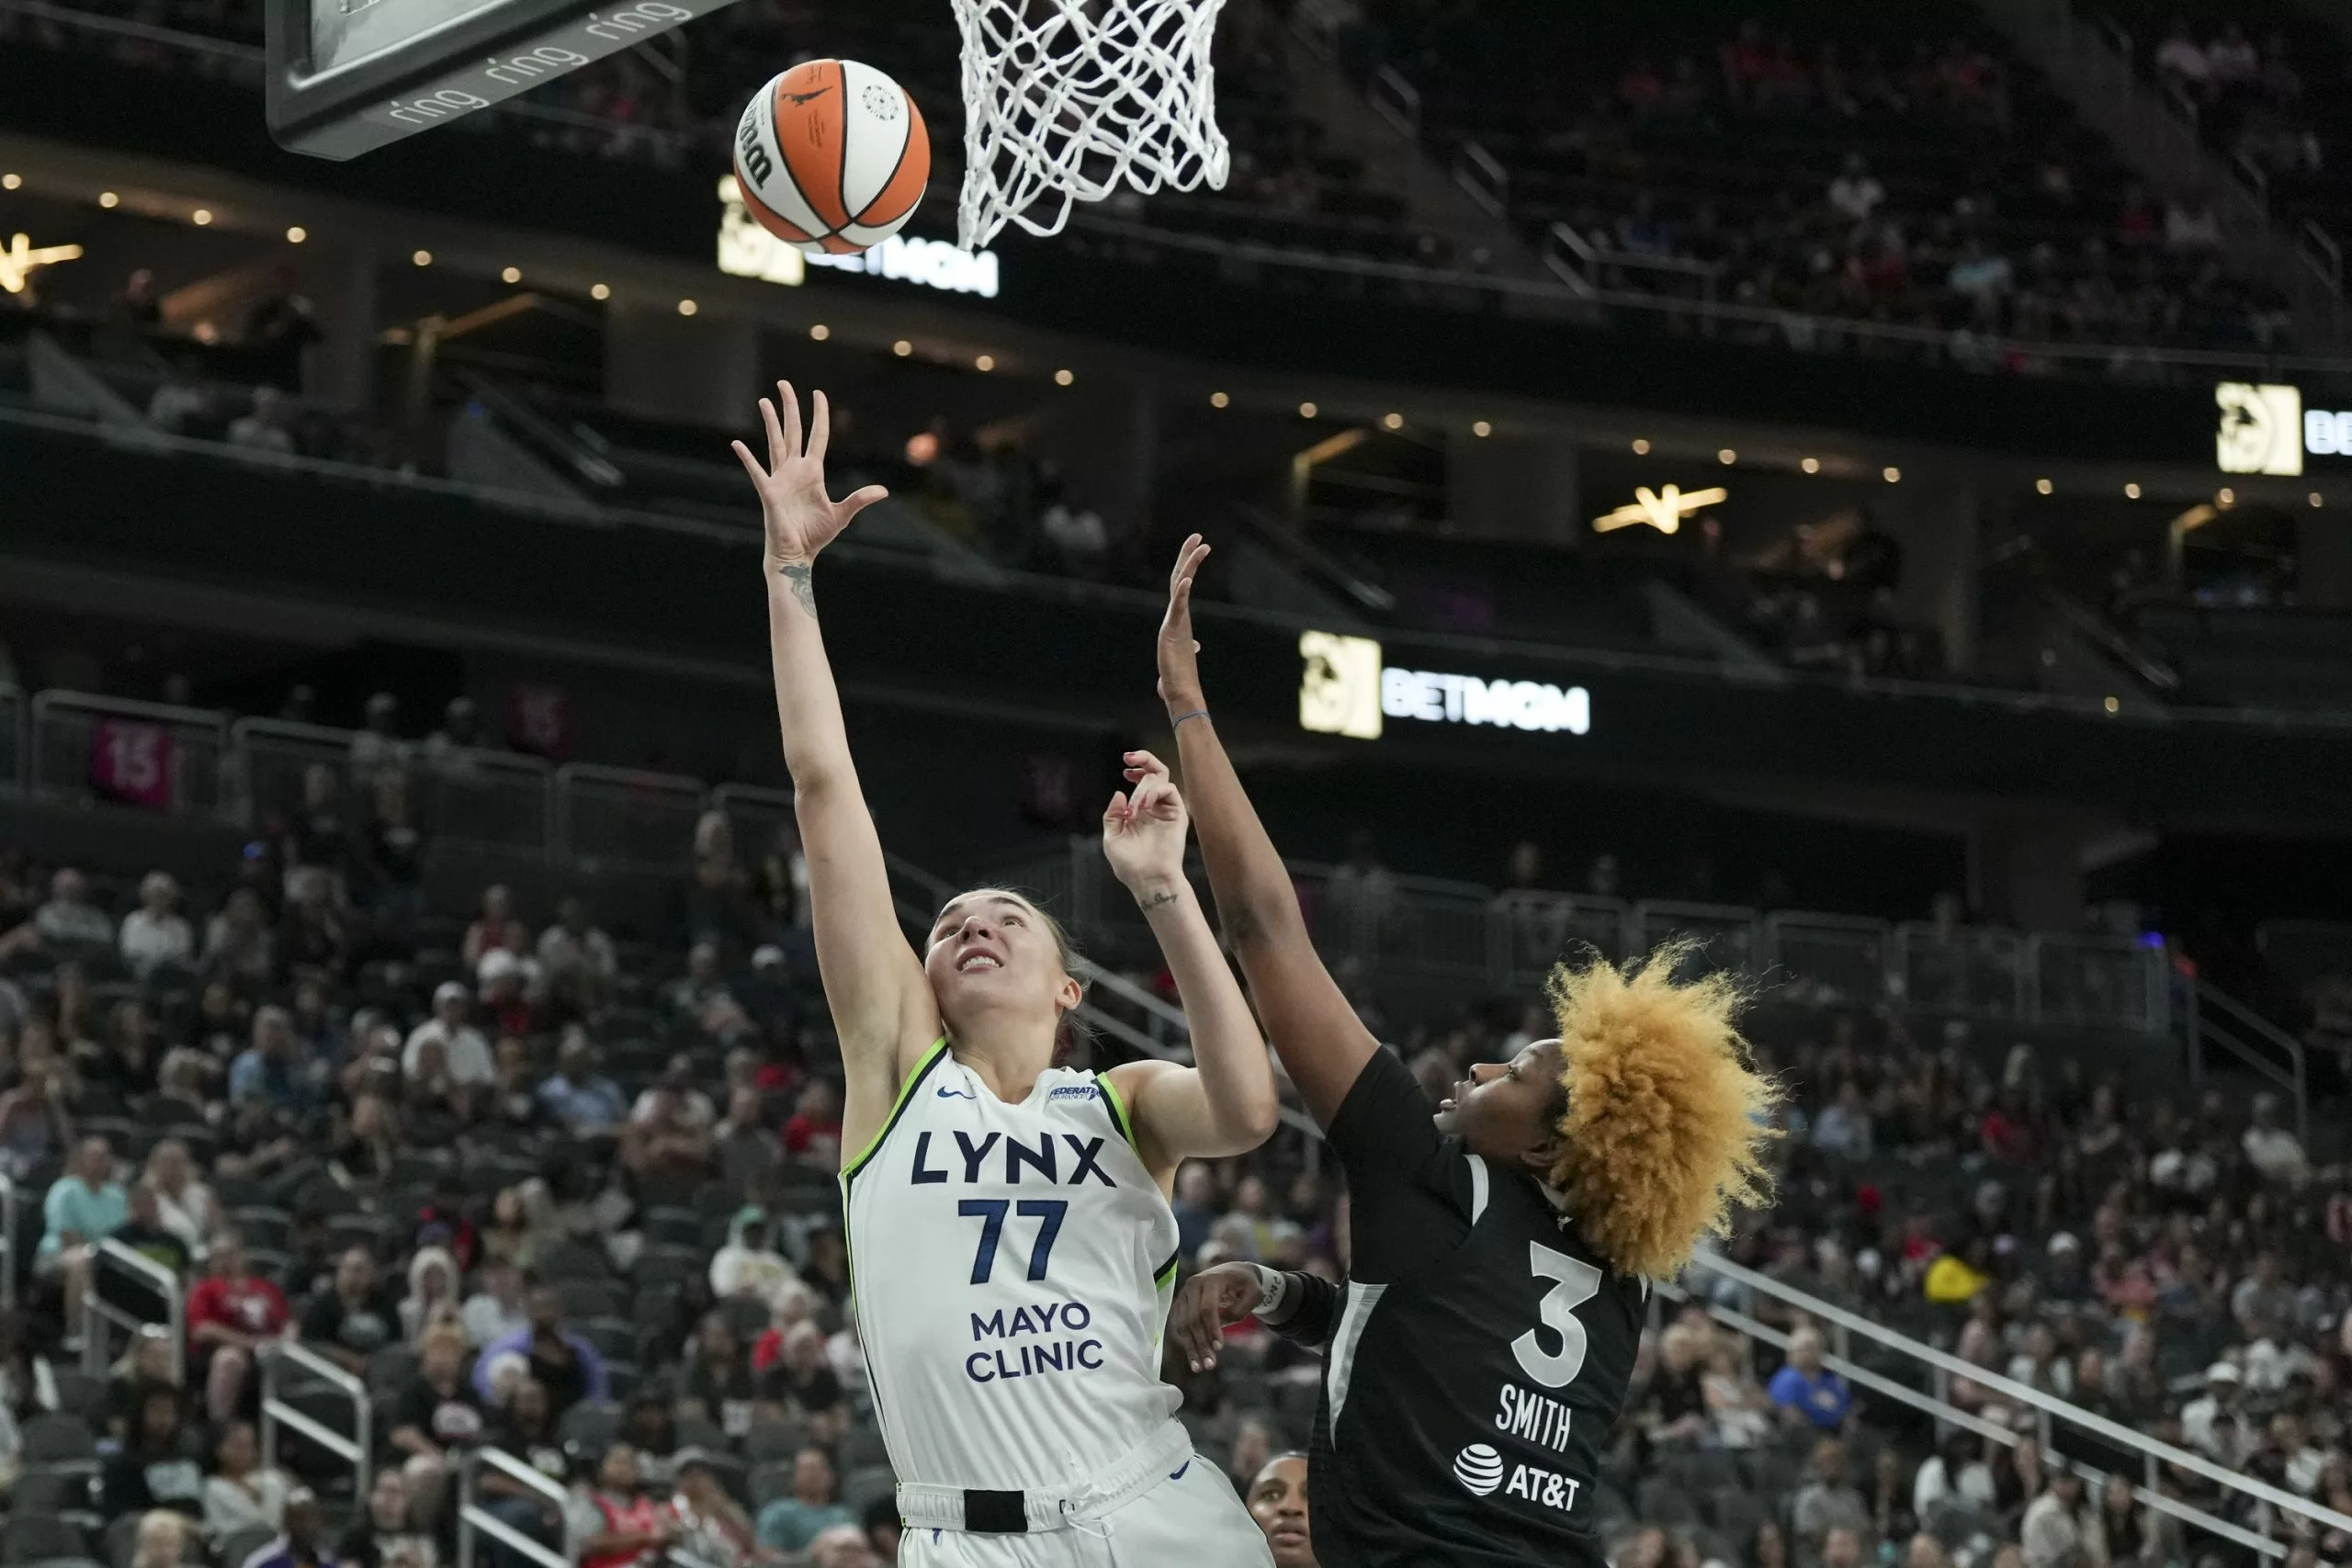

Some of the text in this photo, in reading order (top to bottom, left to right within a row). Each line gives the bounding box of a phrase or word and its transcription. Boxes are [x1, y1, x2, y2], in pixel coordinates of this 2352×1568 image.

[390, 2, 693, 124] ring ring ring
[1381, 667, 1590, 735] BETMGM
[911, 1131, 1117, 1188] LYNX
[958, 1200, 1069, 1284] 77
[970, 1302, 1091, 1341] MAYO
[1510, 1240, 1602, 1388] 3
[966, 1339, 1103, 1382] CLINIC
[1495, 1383, 1571, 1452] SMITH
[1505, 1464, 1579, 1511] AT&T
